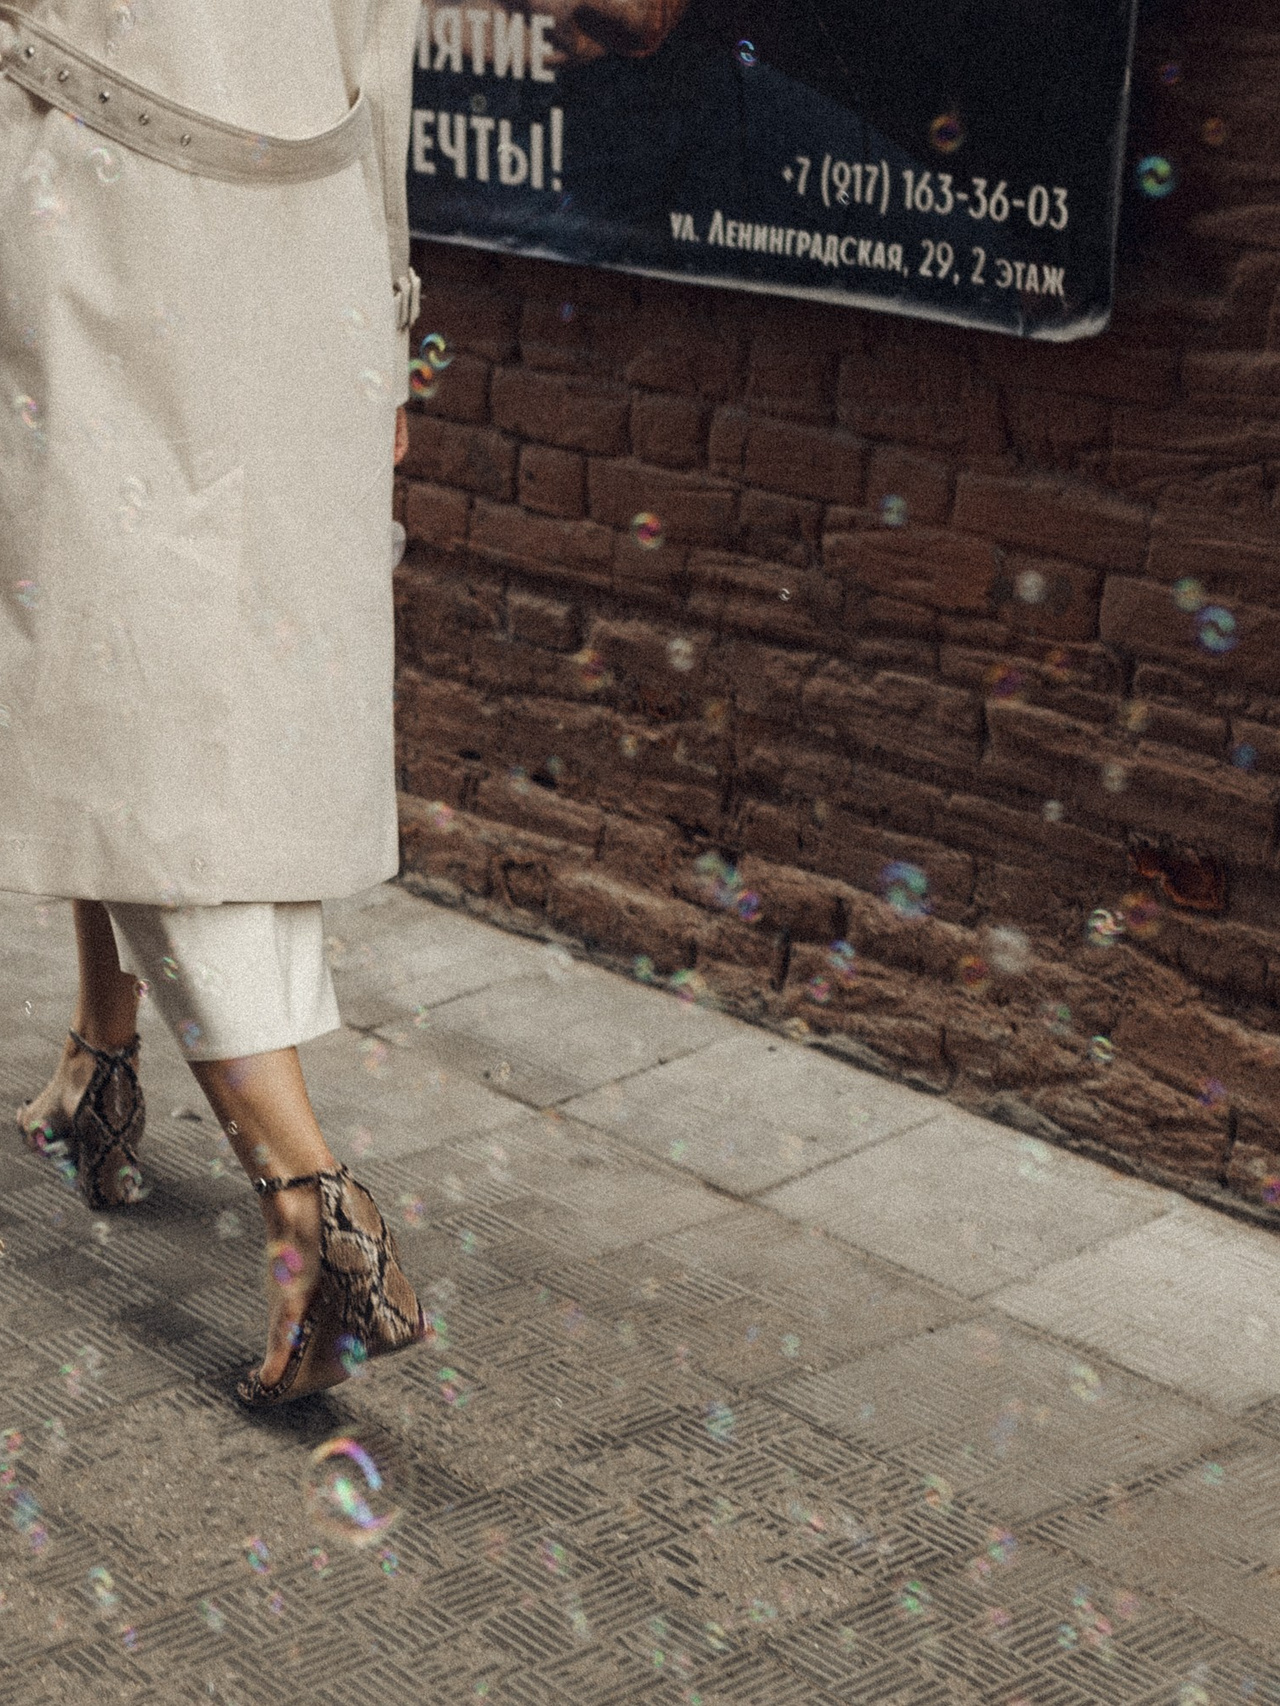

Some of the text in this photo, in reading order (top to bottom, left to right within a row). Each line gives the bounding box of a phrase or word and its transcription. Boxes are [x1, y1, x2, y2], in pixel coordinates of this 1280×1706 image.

[412, 106, 564, 193] ЕЧТЫ!
[780, 153, 1069, 230] +7 (917) 163-36-03
[919, 238, 960, 286] 29,
[970, 246, 986, 286] 2
